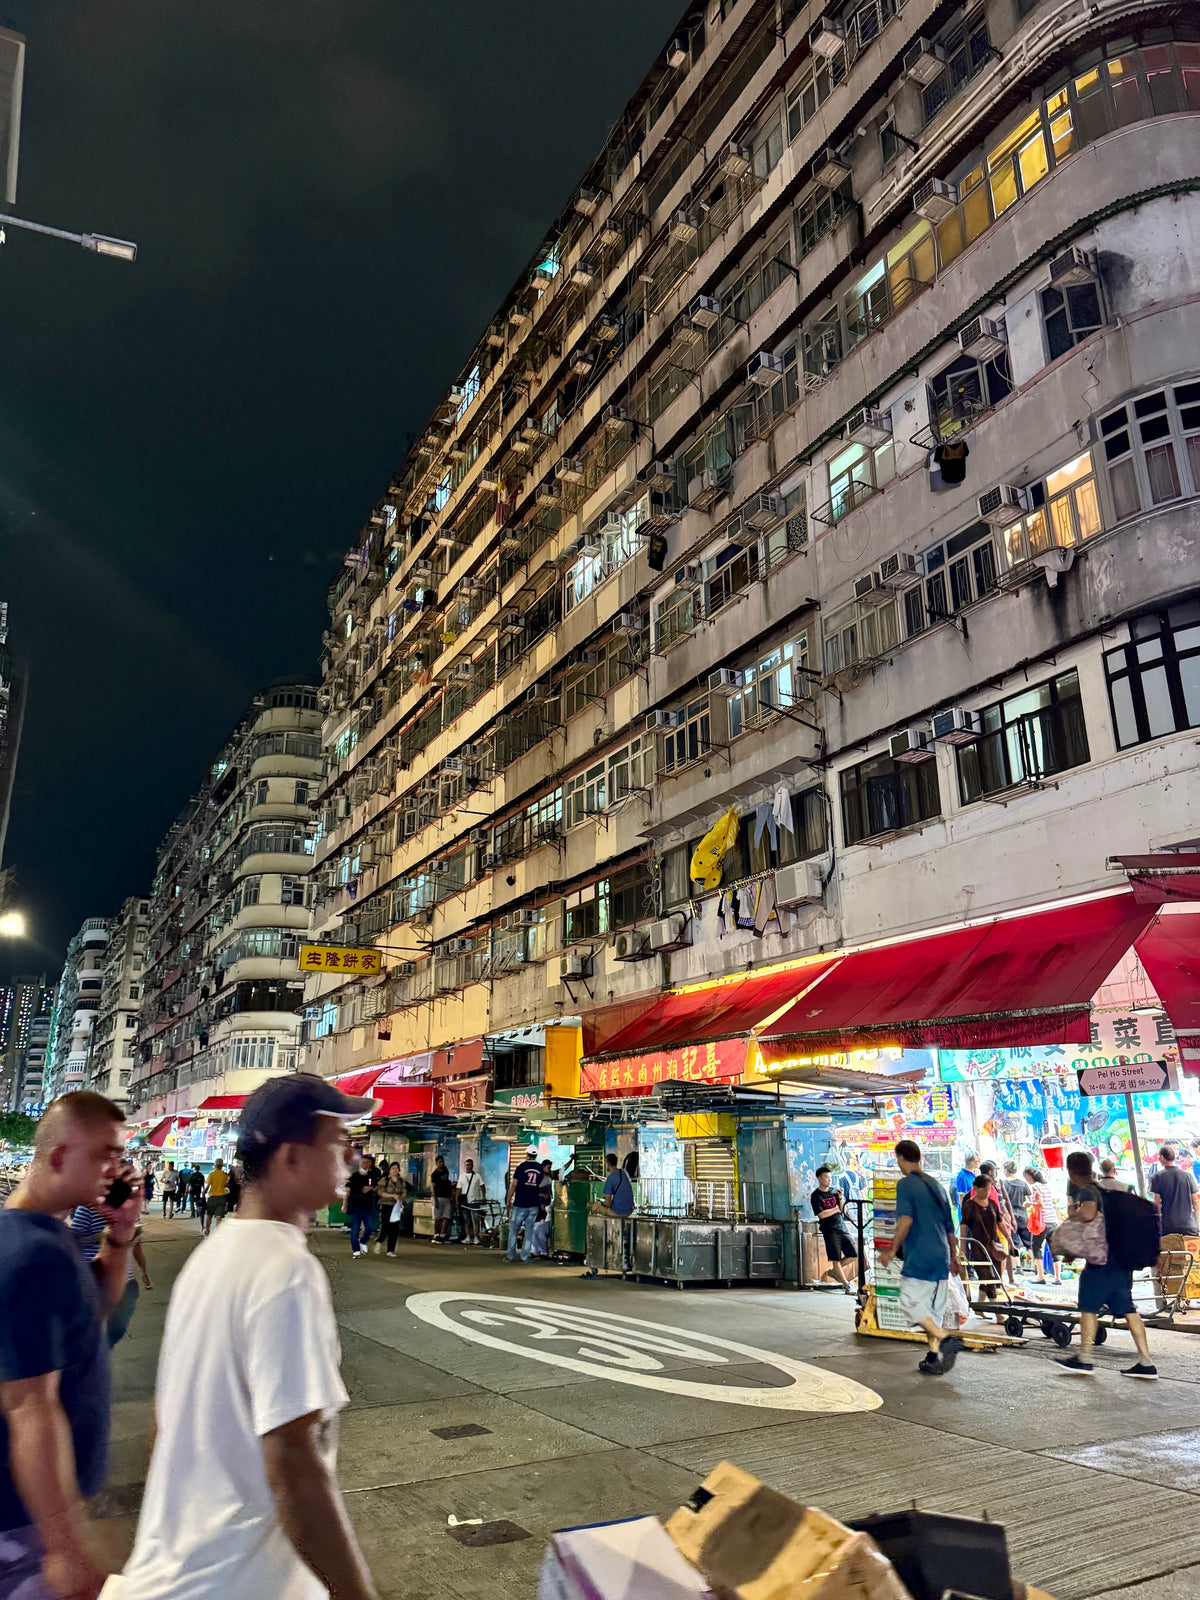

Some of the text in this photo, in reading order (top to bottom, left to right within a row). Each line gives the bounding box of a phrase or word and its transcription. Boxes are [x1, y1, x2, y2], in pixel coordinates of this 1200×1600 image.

[306, 951, 377, 969] 生隆餅家
[1097, 1067, 1144, 1079] Pei Ho Street
[1108, 1079, 1137, 1091] 北河街
[527, 1171, 537, 1184] 71
[459, 1305, 730, 1371] 30
